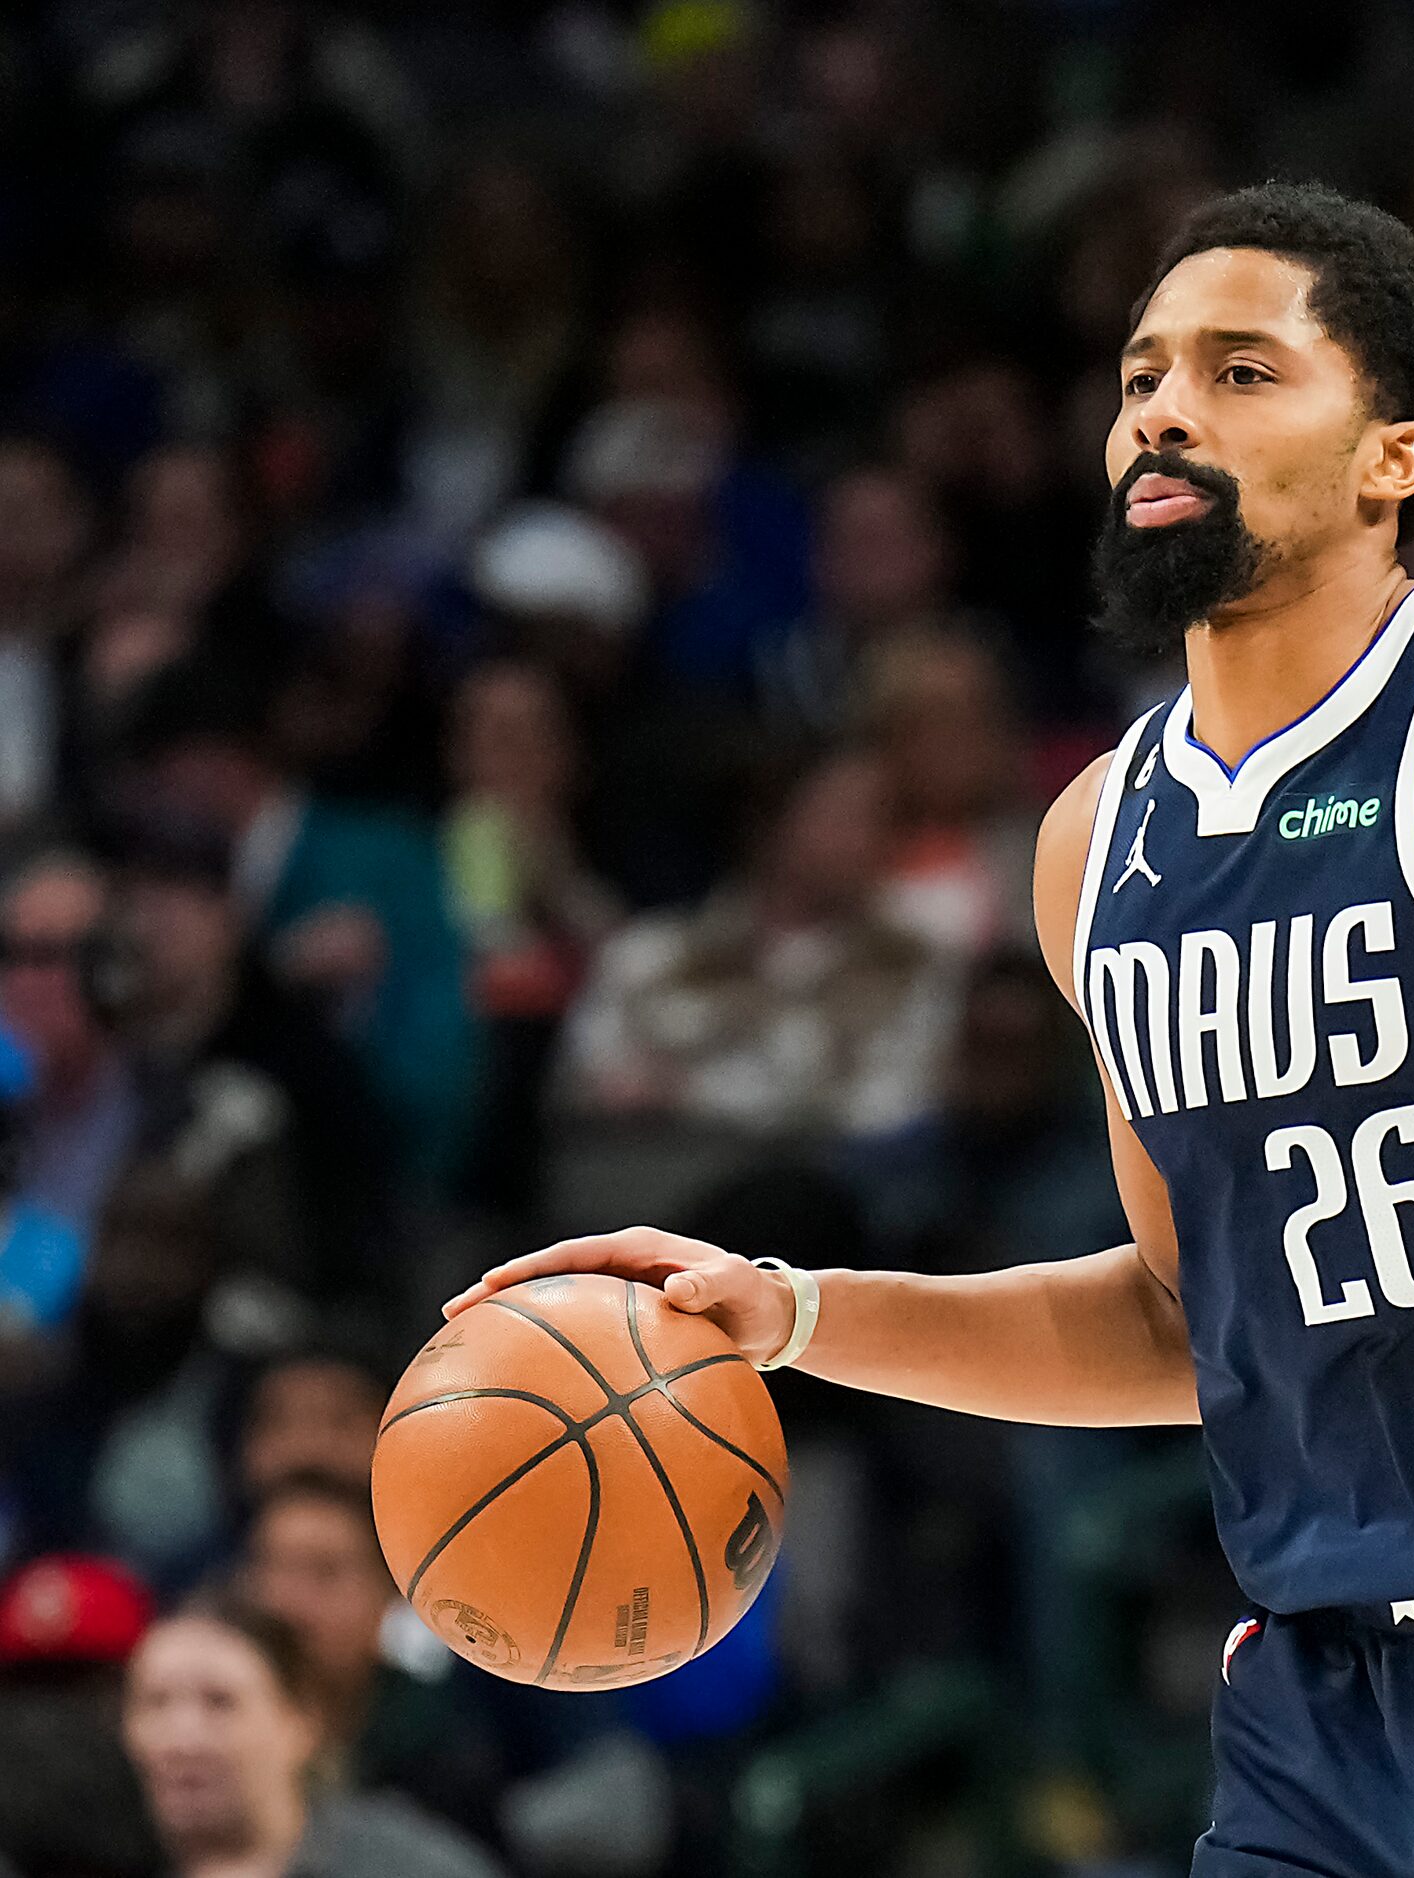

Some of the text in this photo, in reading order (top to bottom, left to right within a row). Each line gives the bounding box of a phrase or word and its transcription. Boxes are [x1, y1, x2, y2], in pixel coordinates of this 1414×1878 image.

[1134, 743, 1161, 790] 6
[1278, 795, 1381, 840] chime
[1088, 900, 1409, 1121] MAVS
